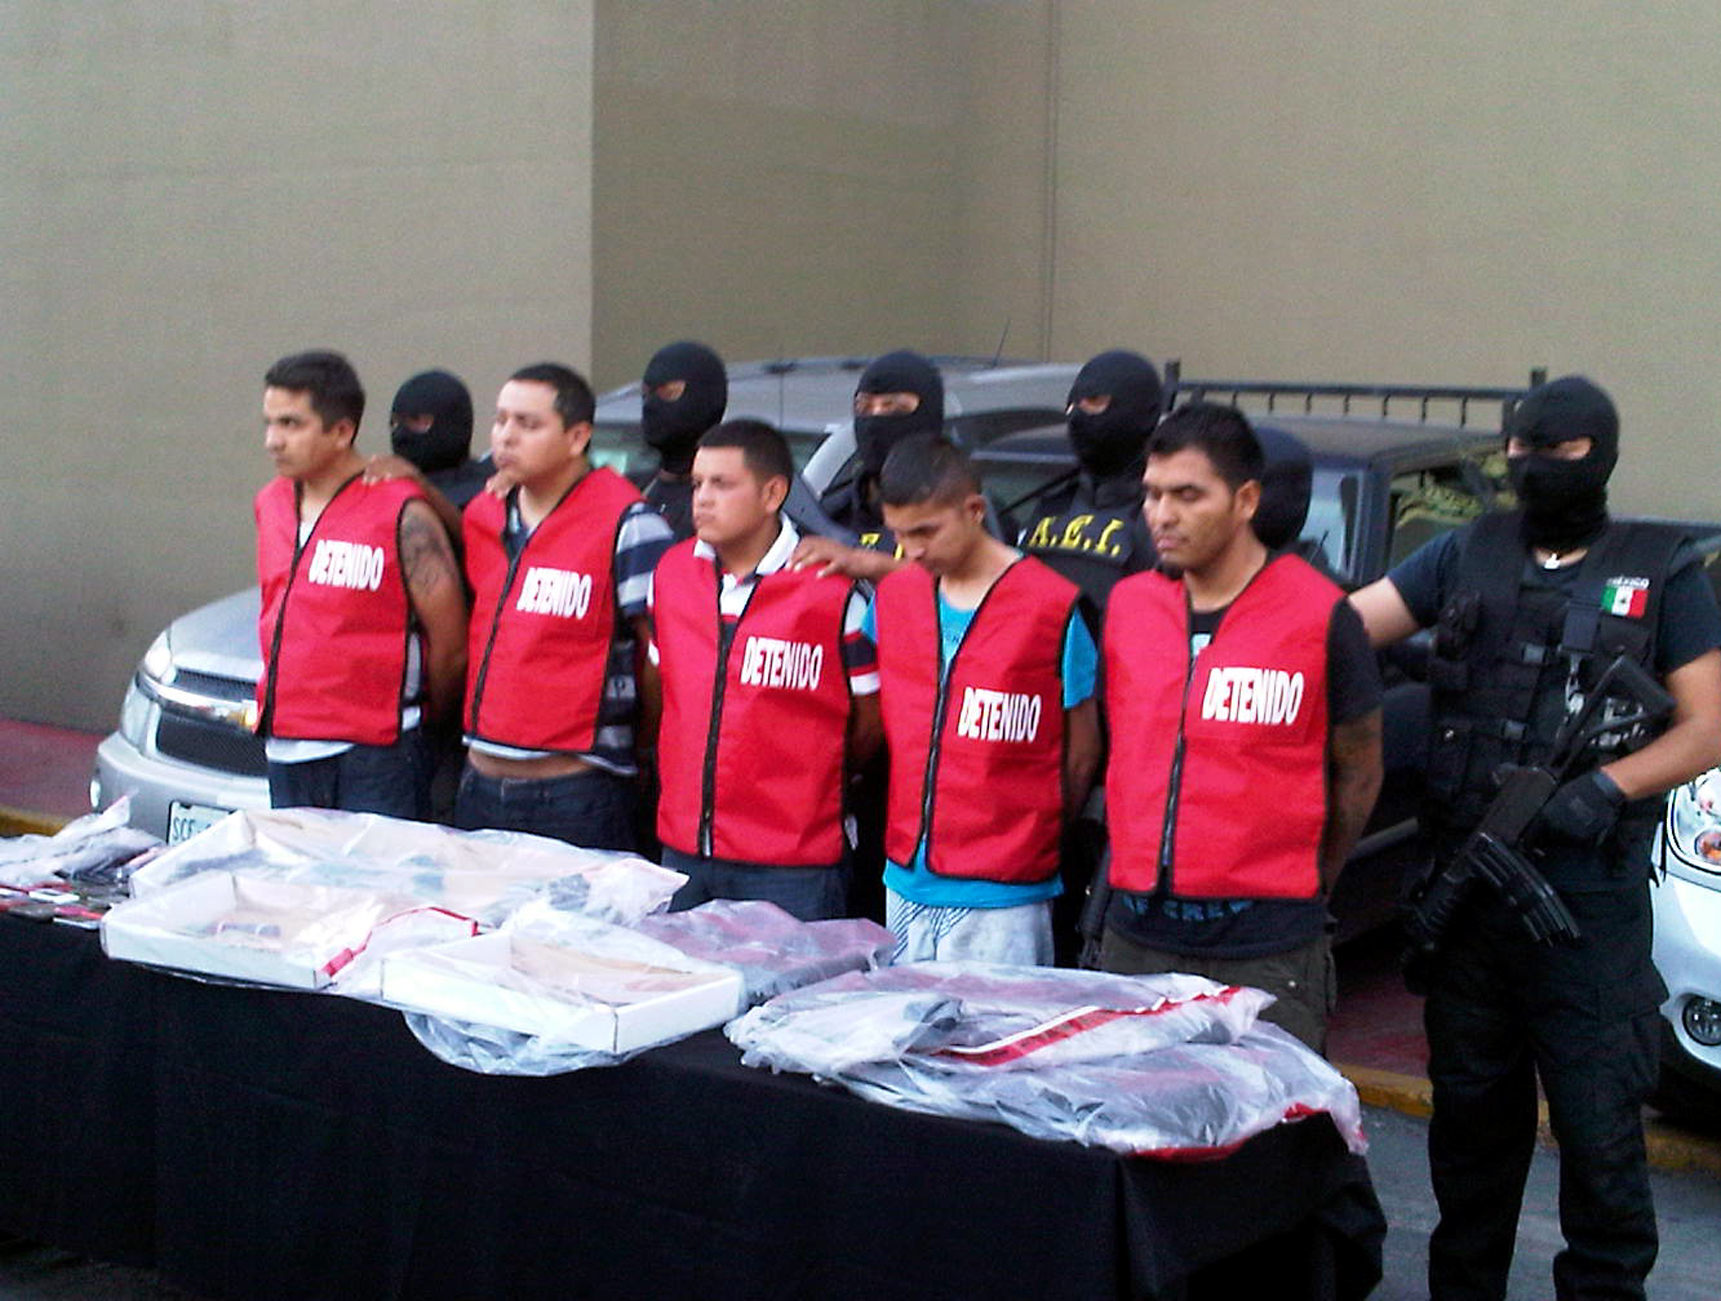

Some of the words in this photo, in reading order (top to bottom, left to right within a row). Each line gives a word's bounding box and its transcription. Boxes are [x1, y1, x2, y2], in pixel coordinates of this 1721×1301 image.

[309, 540, 384, 591] DETENIDO
[517, 567, 592, 619] DETENIDO
[740, 636, 823, 691] DETENIDO
[957, 687, 1041, 743] DETENIDO
[1202, 667, 1304, 726] DETENIDO
